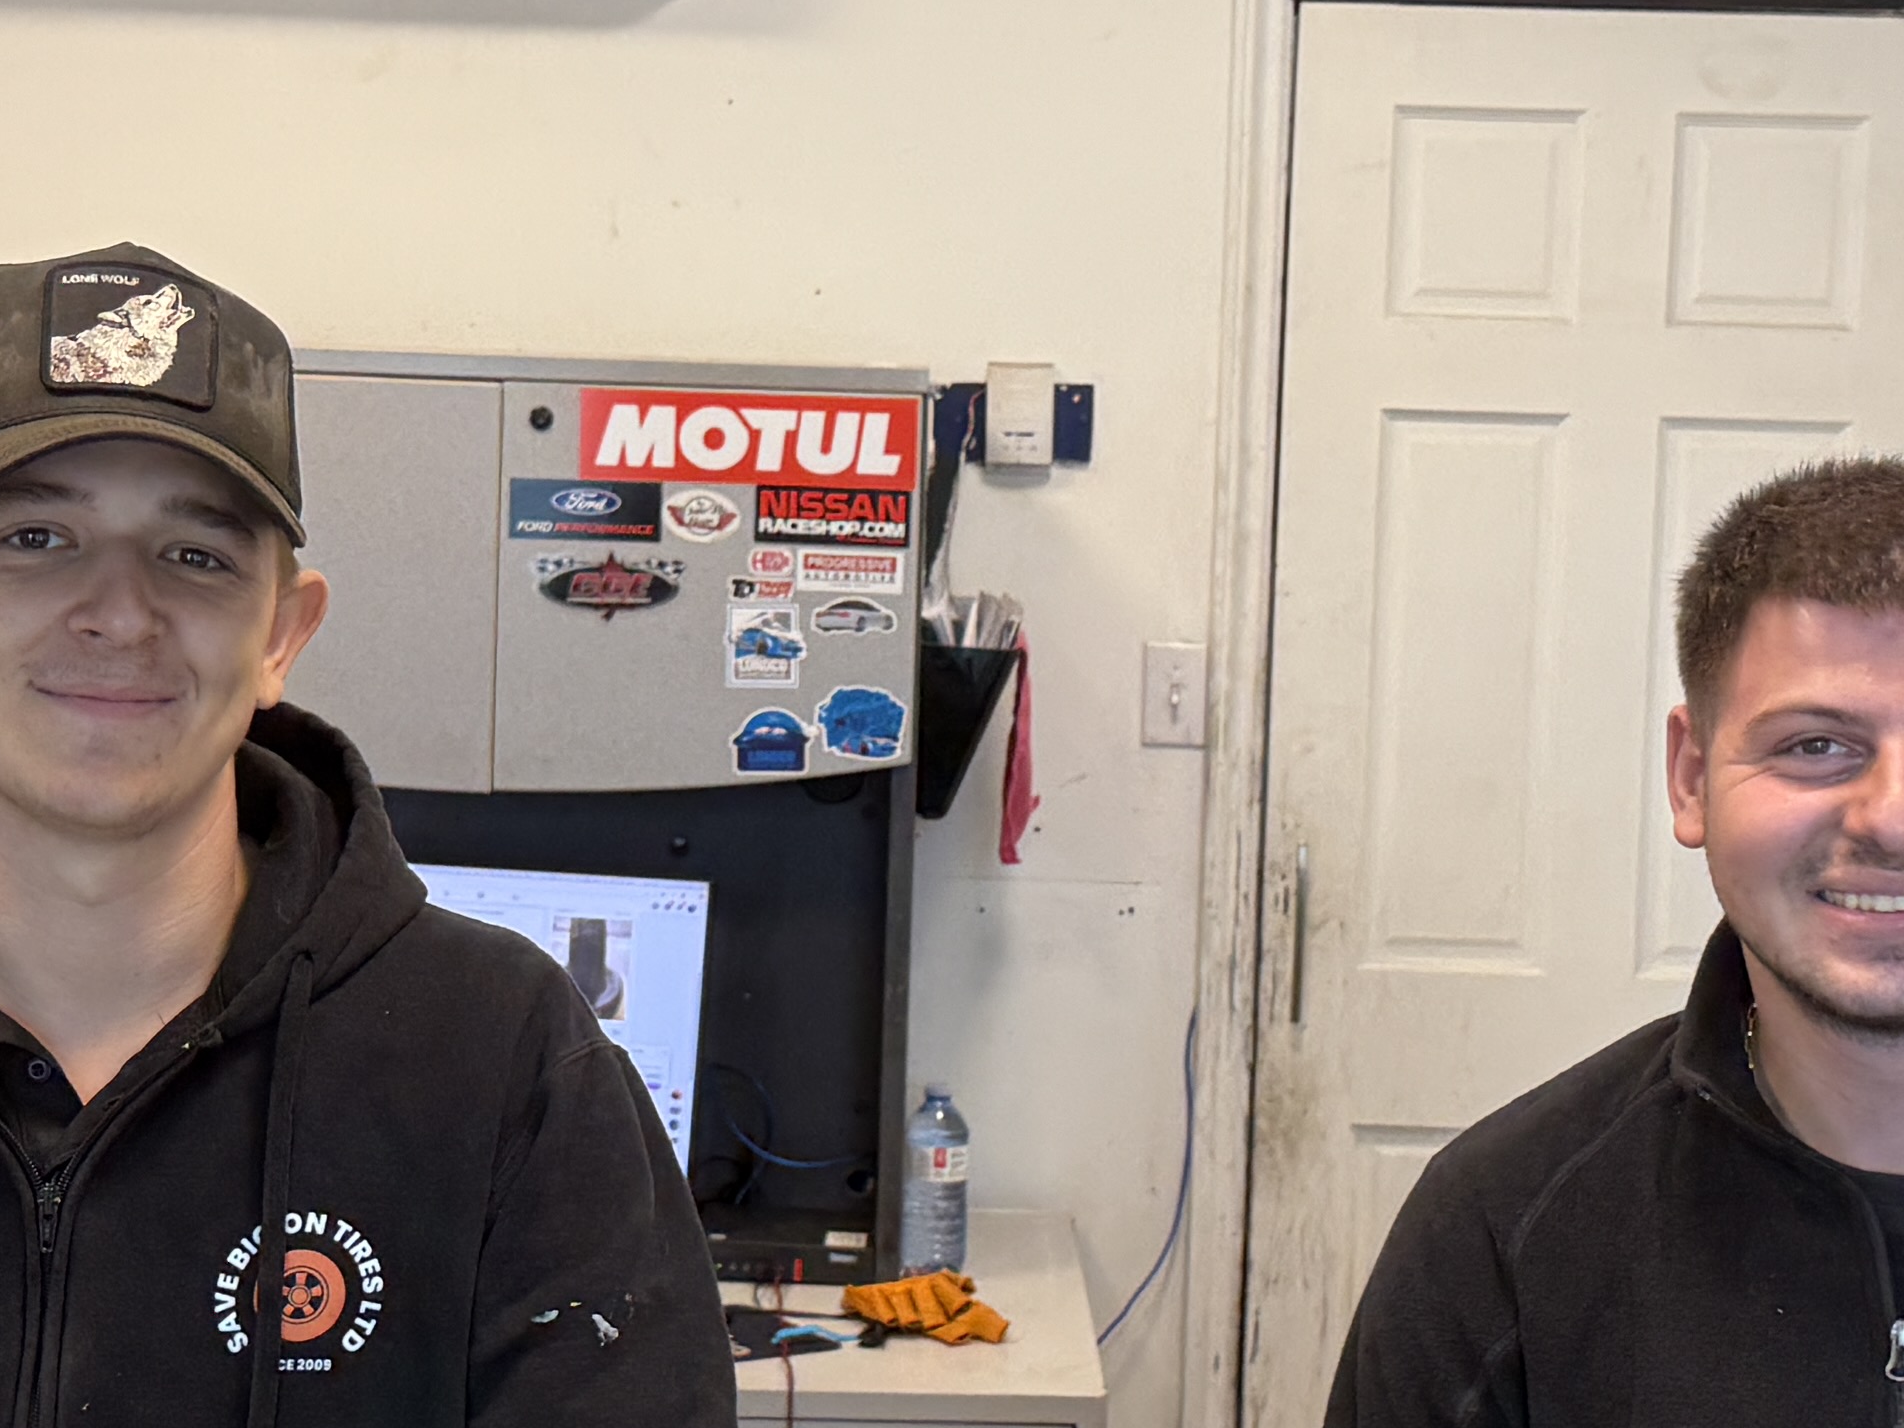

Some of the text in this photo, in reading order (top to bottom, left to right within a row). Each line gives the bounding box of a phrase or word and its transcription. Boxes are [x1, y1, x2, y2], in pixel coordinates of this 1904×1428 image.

[62, 274, 98, 284] LONE
[596, 404, 901, 476] MOTUL
[565, 492, 608, 512] Ford
[760, 490, 906, 523] NISSAN
[517, 521, 655, 535] FORD PERFORMANCE
[758, 518, 905, 538] RACESHOP.COM
[284, 1212, 328, 1235] ON
[332, 1219, 384, 1294] TIRES
[214, 1273, 249, 1354] SAVE
[342, 1300, 382, 1353] LTD
[297, 1358, 332, 1371] 2009
